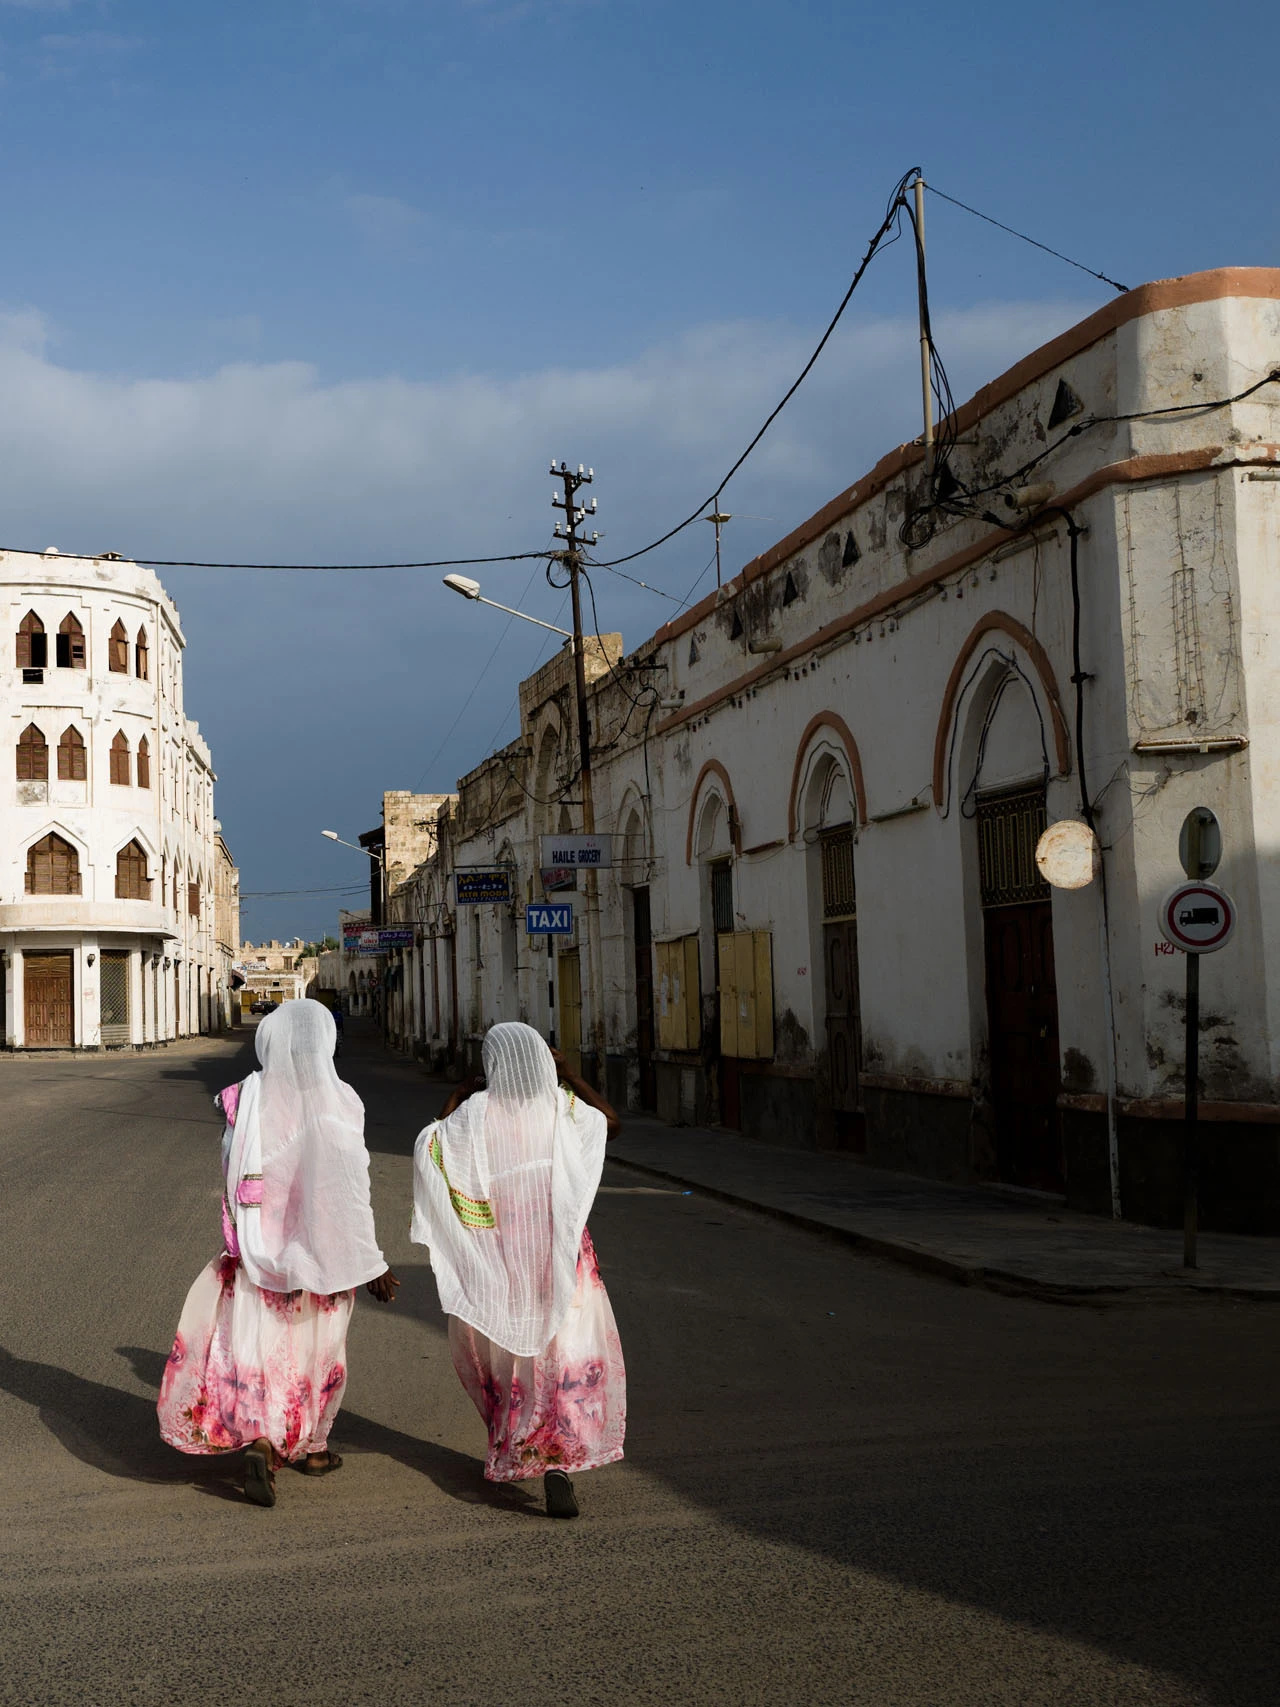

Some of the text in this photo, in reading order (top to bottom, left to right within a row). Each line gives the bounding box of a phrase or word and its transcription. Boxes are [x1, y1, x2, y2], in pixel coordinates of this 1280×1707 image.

[552, 849, 601, 864] HAILE GROCERY
[529, 910, 568, 928] TAXI
